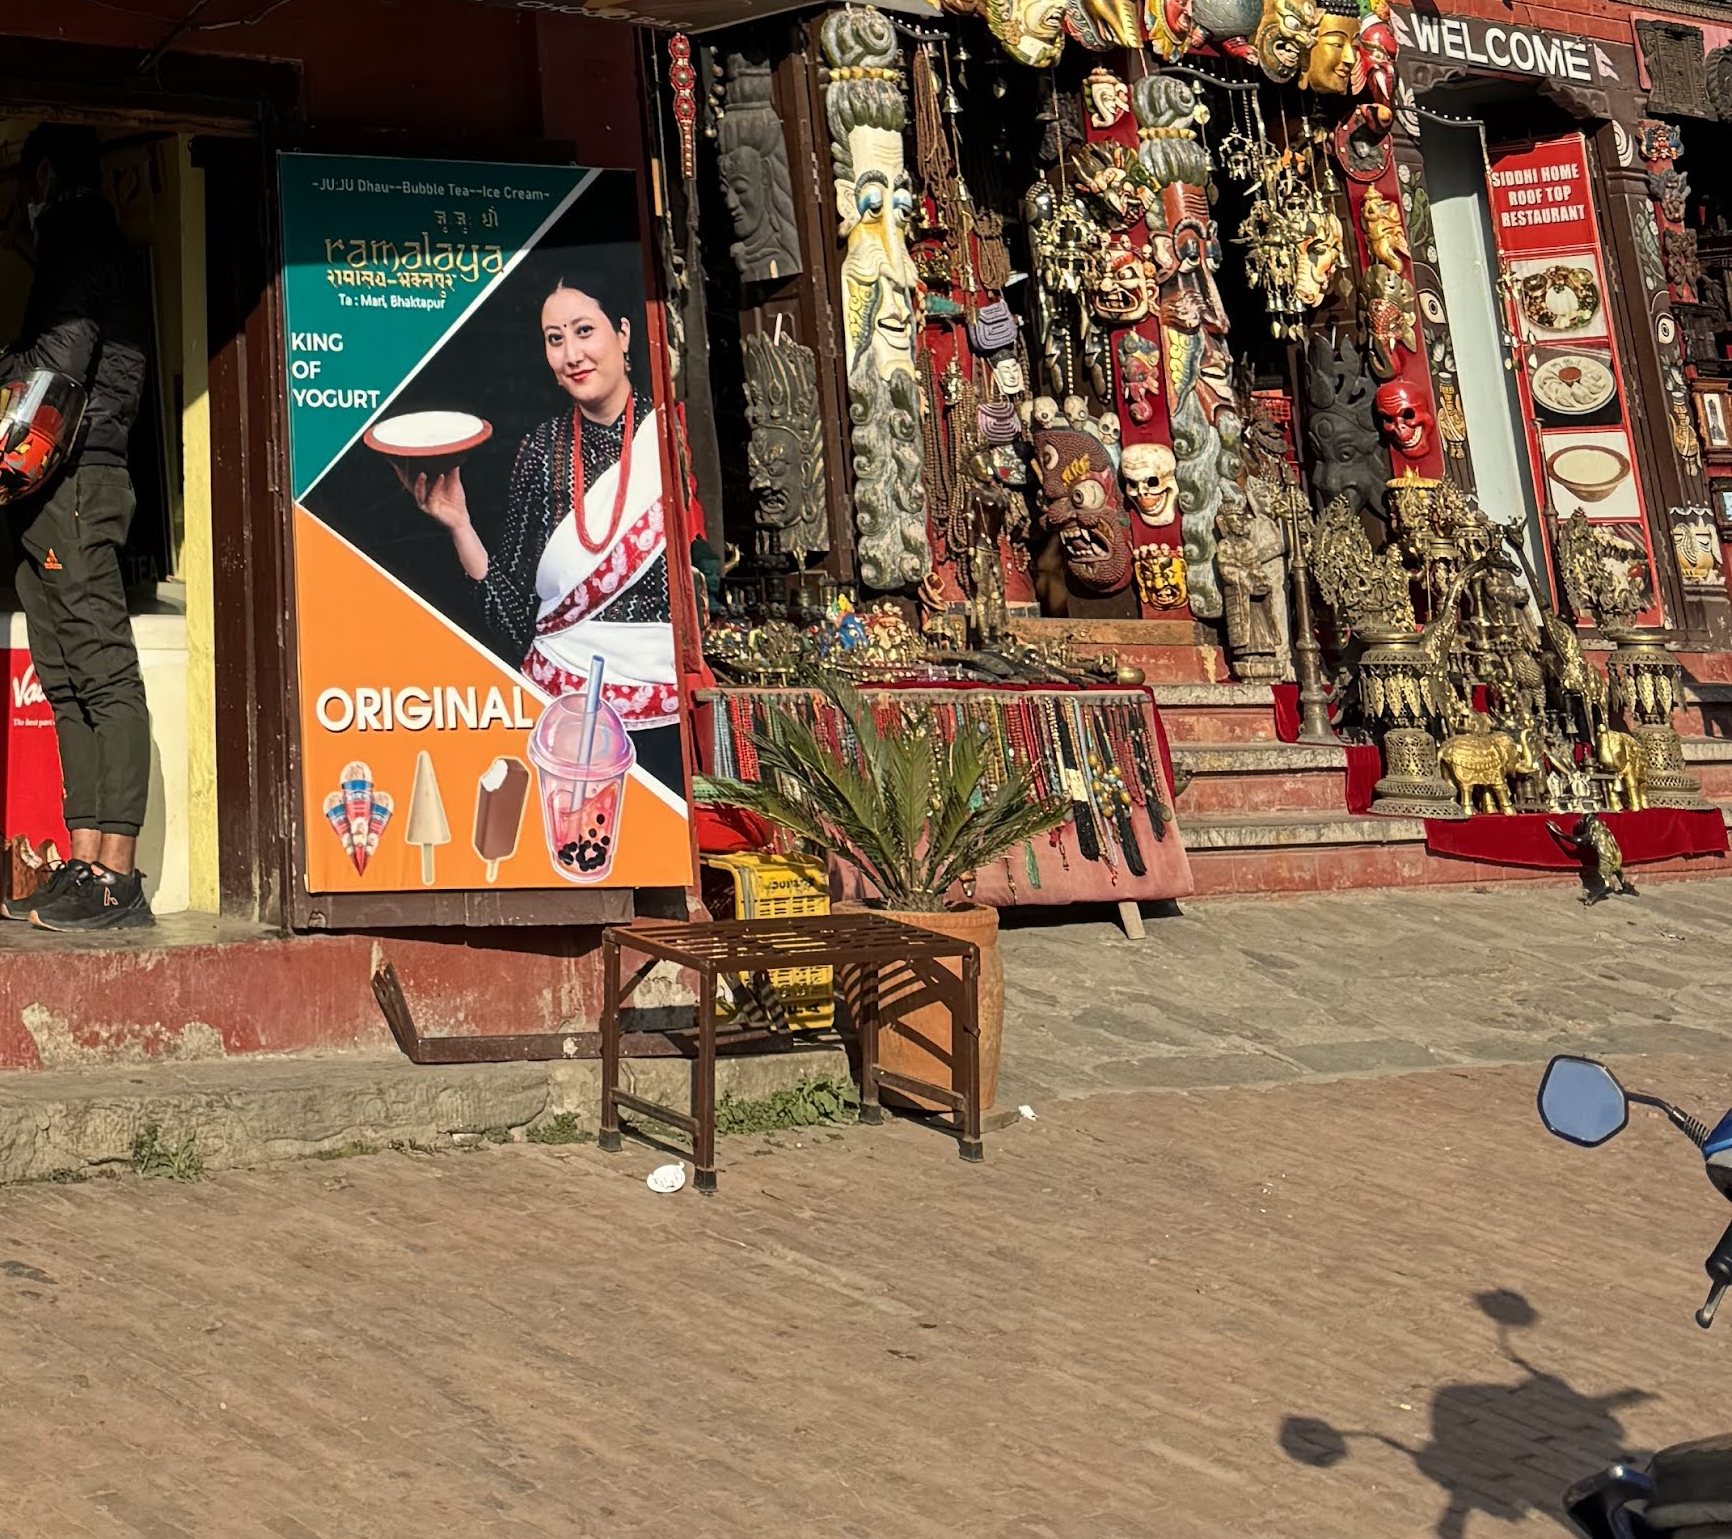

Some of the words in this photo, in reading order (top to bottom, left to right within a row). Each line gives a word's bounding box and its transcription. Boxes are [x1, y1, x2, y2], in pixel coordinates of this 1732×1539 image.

[1410, 13, 1592, 80] WELCOME
[1491, 169, 1539, 187] SIDDHI
[1541, 163, 1580, 182] HOME
[1508, 188, 1542, 207] ROOF
[1544, 185, 1571, 203] TOP
[1500, 204, 1585, 227] RESTAURANT
[324, 232, 504, 283] ramalaya
[390, 295, 445, 311] Bhaktapur
[291, 332, 344, 351] KING
[291, 361, 321, 379] OF
[293, 389, 380, 409] YOGURT
[316, 686, 534, 733] ORIGINAL
